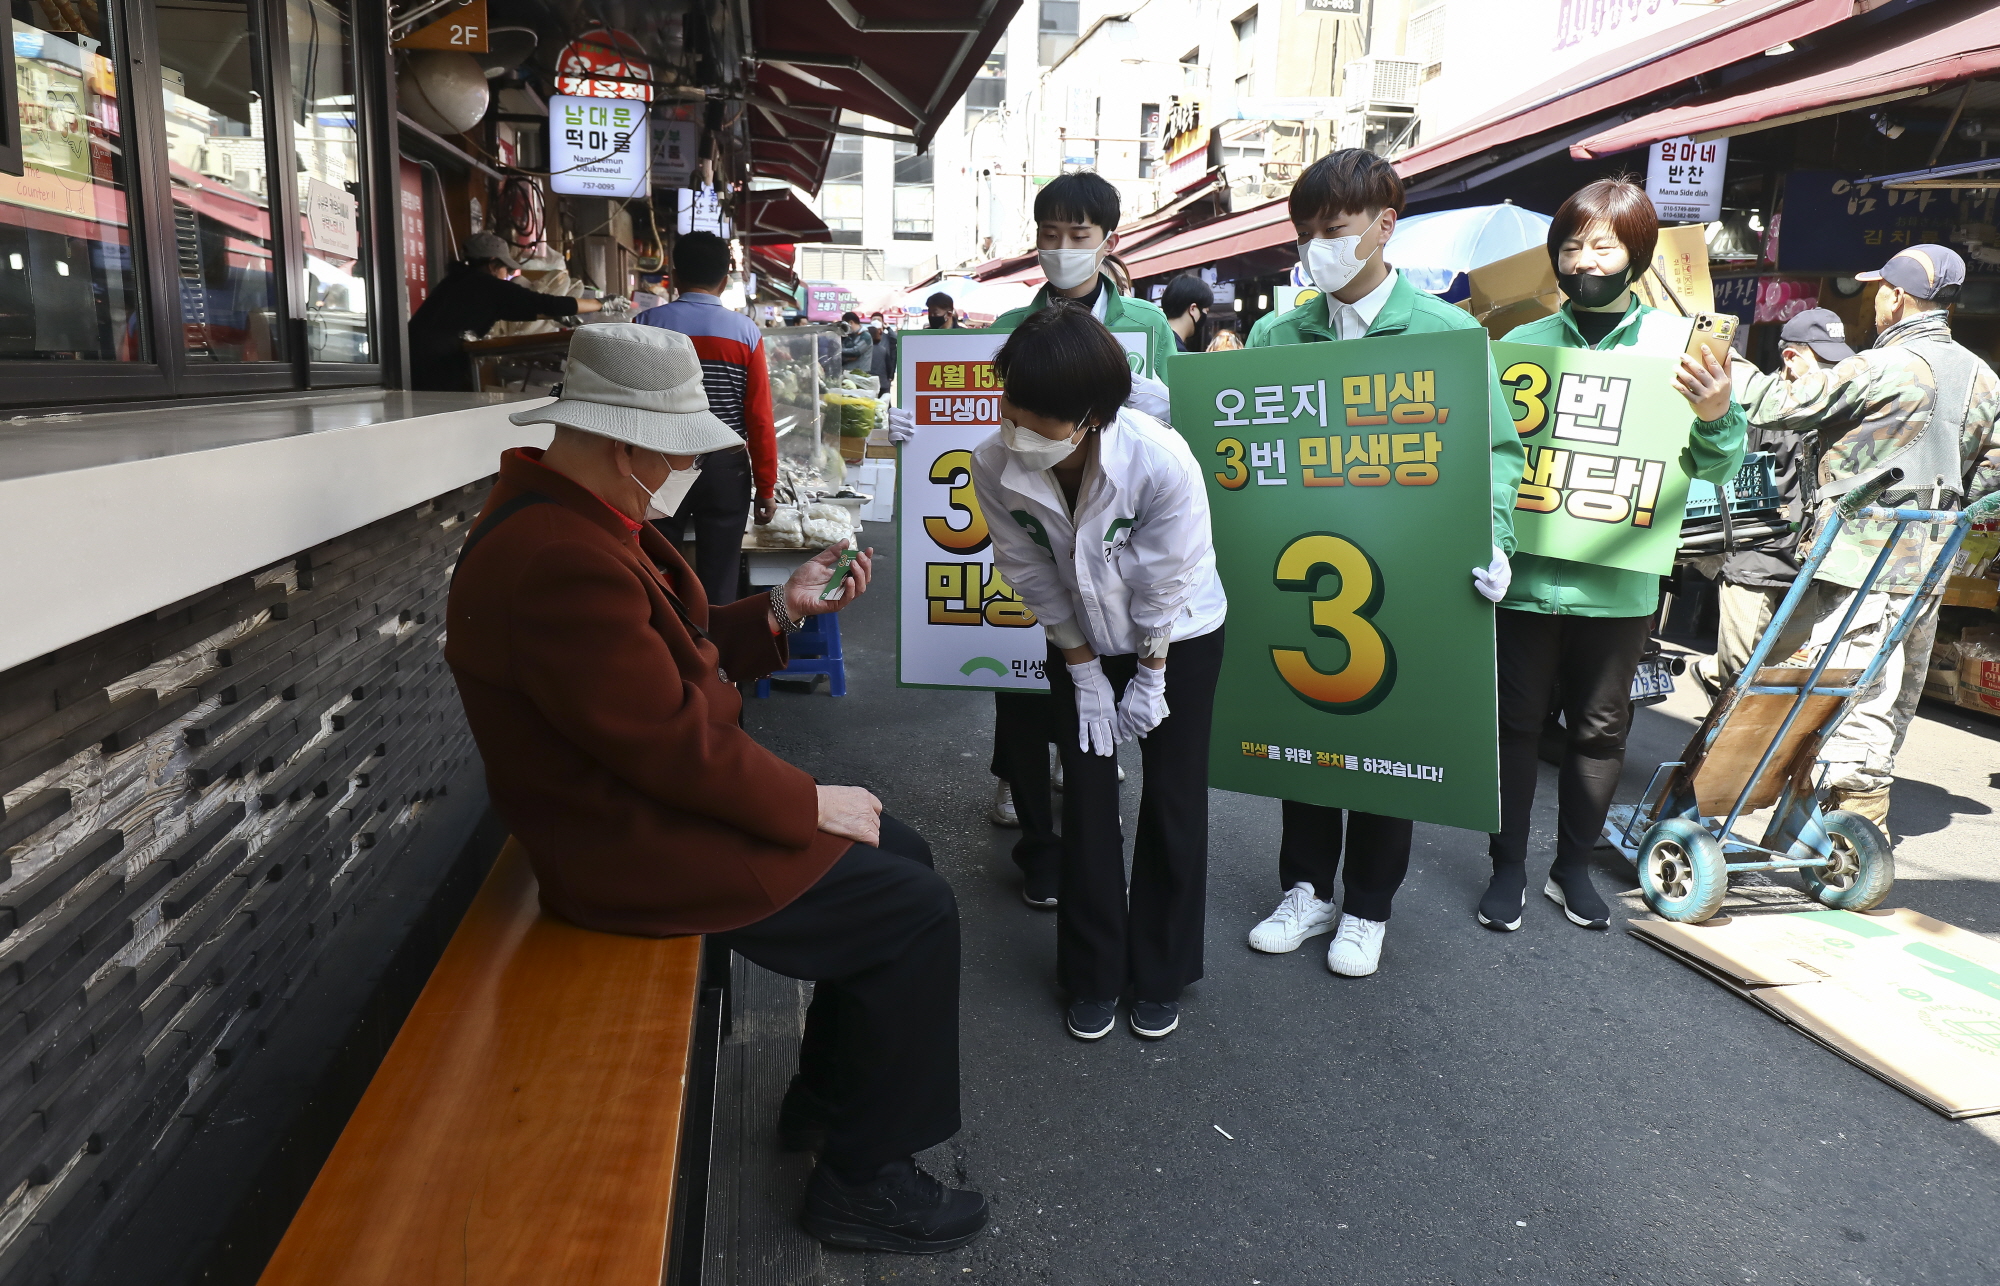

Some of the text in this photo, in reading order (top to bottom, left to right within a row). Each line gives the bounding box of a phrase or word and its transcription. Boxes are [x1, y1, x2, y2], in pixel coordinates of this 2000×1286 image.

[450, 25, 478, 45] 2F
[565, 105, 631, 128] 남대문
[566, 129, 631, 153] 떡마을
[1661, 142, 1716, 163] 엄마네
[582, 181, 615, 191] 757-0095
[1668, 165, 1704, 185] 반찬
[1658, 188, 1679, 196] Mama
[1680, 189, 1694, 197] Side
[1715, 279, 1754, 306] 반찬
[928, 364, 1005, 389] 4월 15
[929, 397, 1002, 422] 민생이
[1213, 370, 1449, 427] 오로지 민생,
[1500, 362, 1631, 446] 3번
[1214, 431, 1443, 492] 3번 민생당
[1514, 444, 1667, 529] 생당!
[923, 449, 992, 556] 3
[925, 561, 1039, 628] 민생
[1268, 531, 1397, 715] 3
[1011, 659, 1046, 679] 민생
[1241, 741, 1444, 783] 민생을 위한 정치를 하겠습니다!
